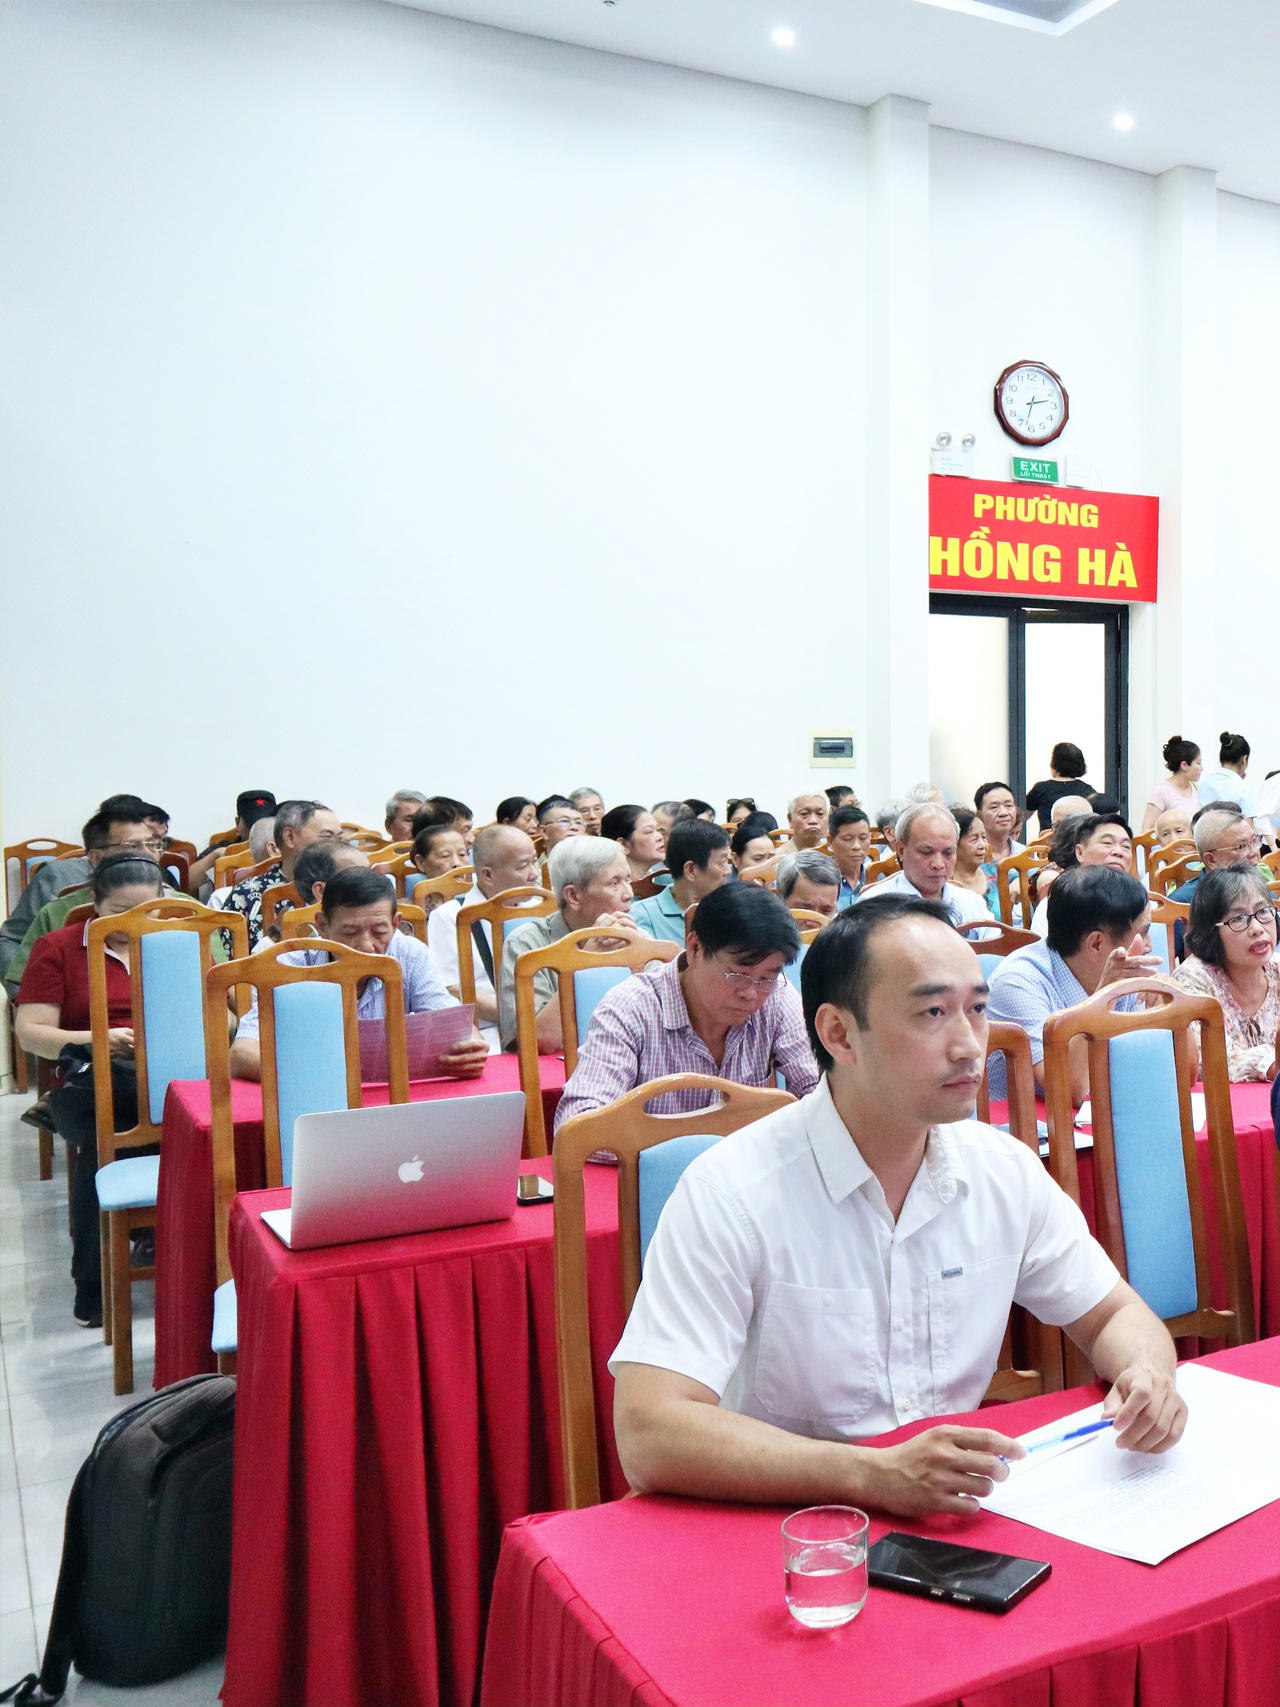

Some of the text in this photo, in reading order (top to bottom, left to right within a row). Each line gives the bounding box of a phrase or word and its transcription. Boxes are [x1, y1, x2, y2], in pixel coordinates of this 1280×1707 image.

[1027, 373, 1037, 381] 12
[1006, 396, 1013, 404] 9
[1050, 402, 1057, 410] 3
[1027, 425, 1036, 433] 6
[1038, 422, 1045, 430] 5
[1020, 460, 1051, 473] EXIT
[973, 494, 1099, 528] PHƯỜNG
[929, 526, 1138, 588] HỒNG HÀ
